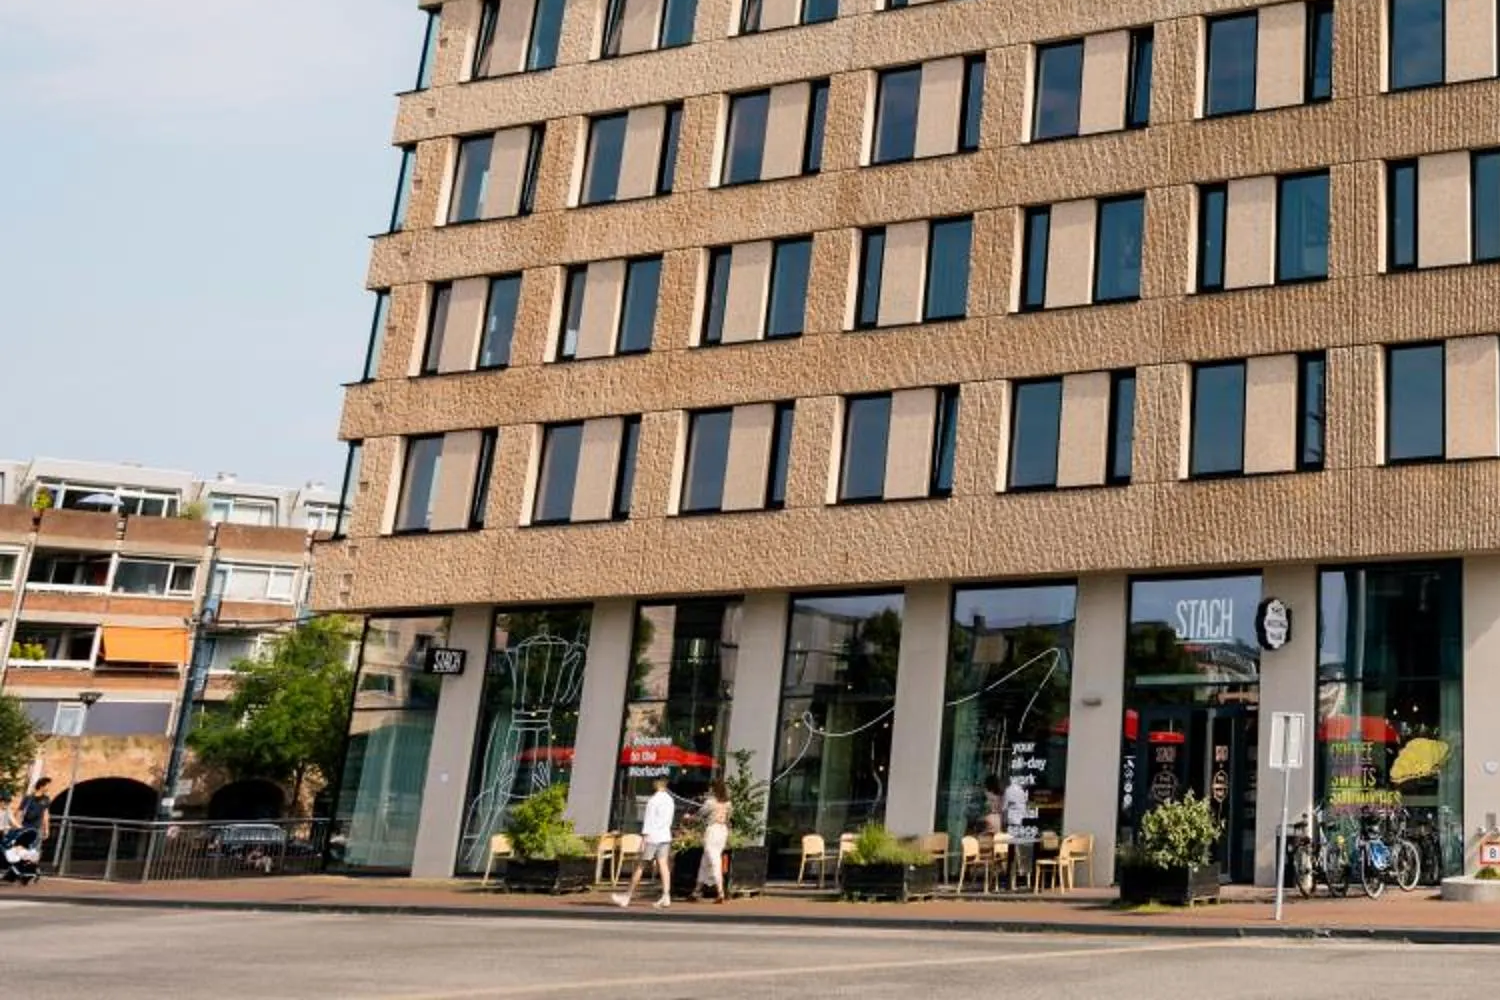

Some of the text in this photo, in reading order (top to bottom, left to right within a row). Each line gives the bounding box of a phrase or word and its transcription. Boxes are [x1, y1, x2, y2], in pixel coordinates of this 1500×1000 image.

[1175, 599, 1233, 639] STACH
[1012, 743, 1036, 755] your
[1011, 757, 1046, 771] all-day
